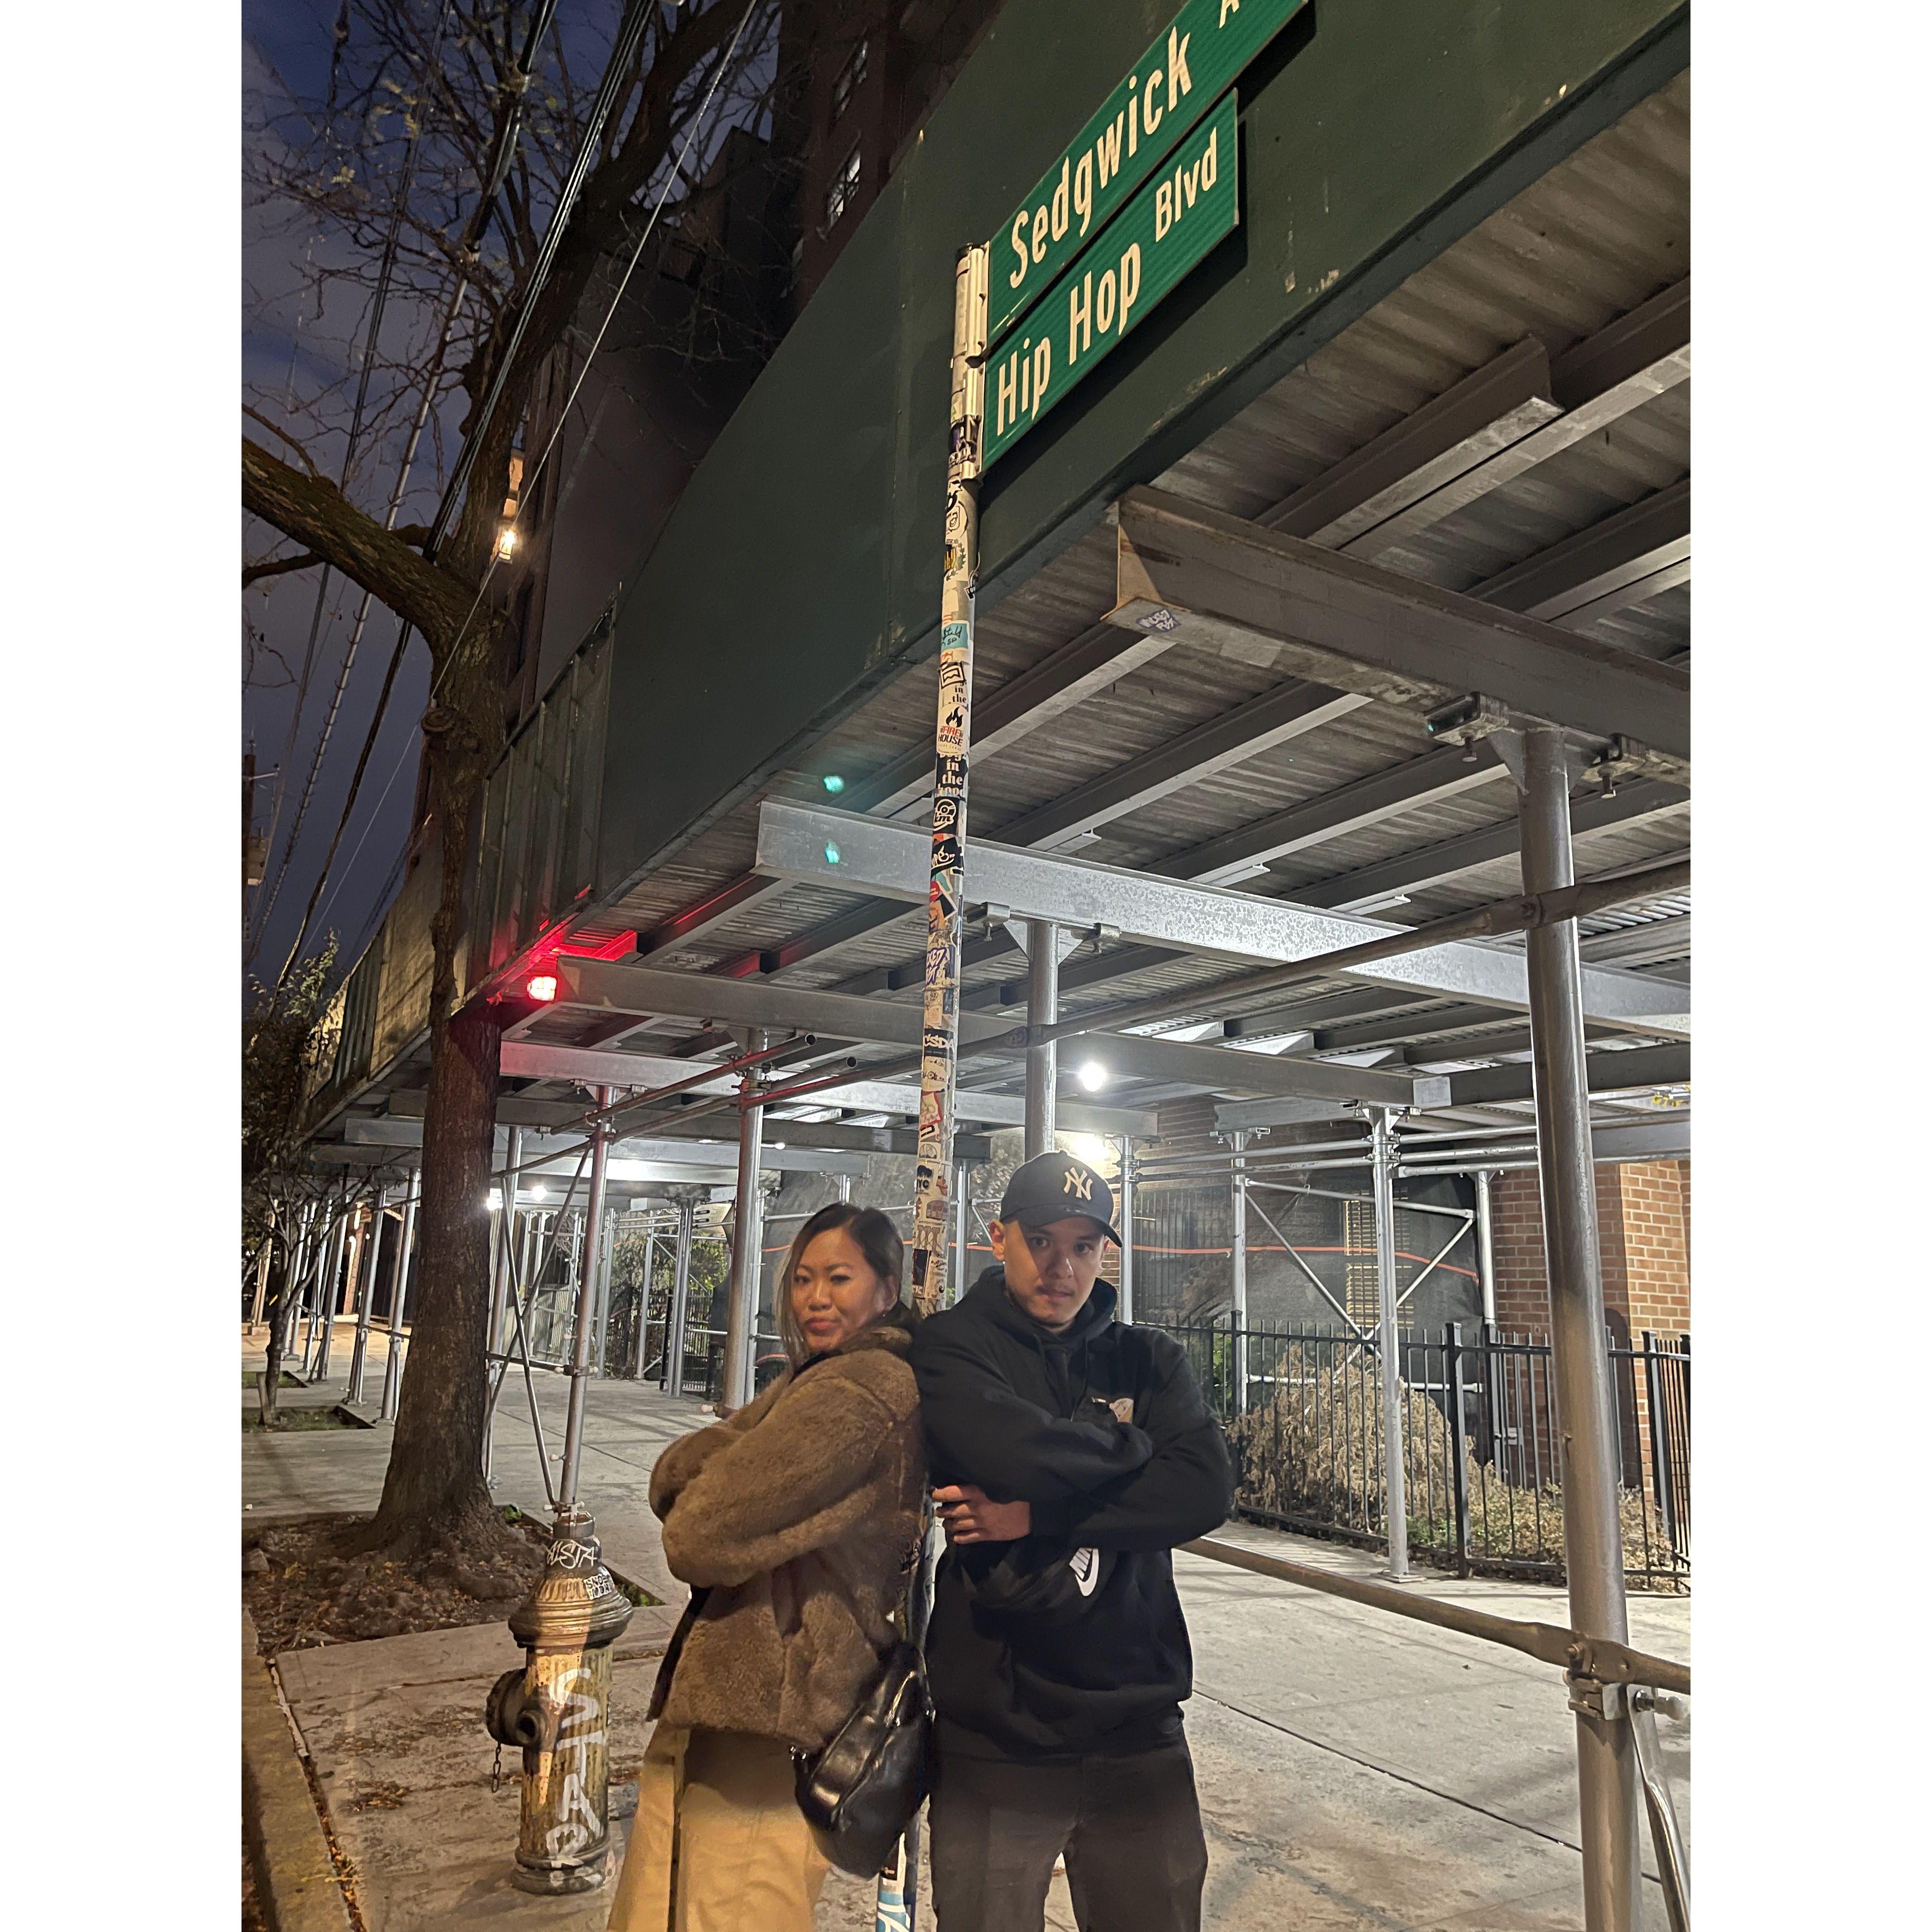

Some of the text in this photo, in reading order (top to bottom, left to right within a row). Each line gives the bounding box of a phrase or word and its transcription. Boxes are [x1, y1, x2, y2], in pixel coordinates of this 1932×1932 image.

[1009, 25, 1193, 289] Sedgwick
[997, 126, 1217, 437] Hip Hop Blvd
[954, 685, 964, 694] in
[952, 694, 967, 704] the
[938, 734, 963, 747] HOUSE
[946, 759, 960, 771] in
[942, 771, 963, 785] the
[1063, 1167, 1093, 1201] NY
